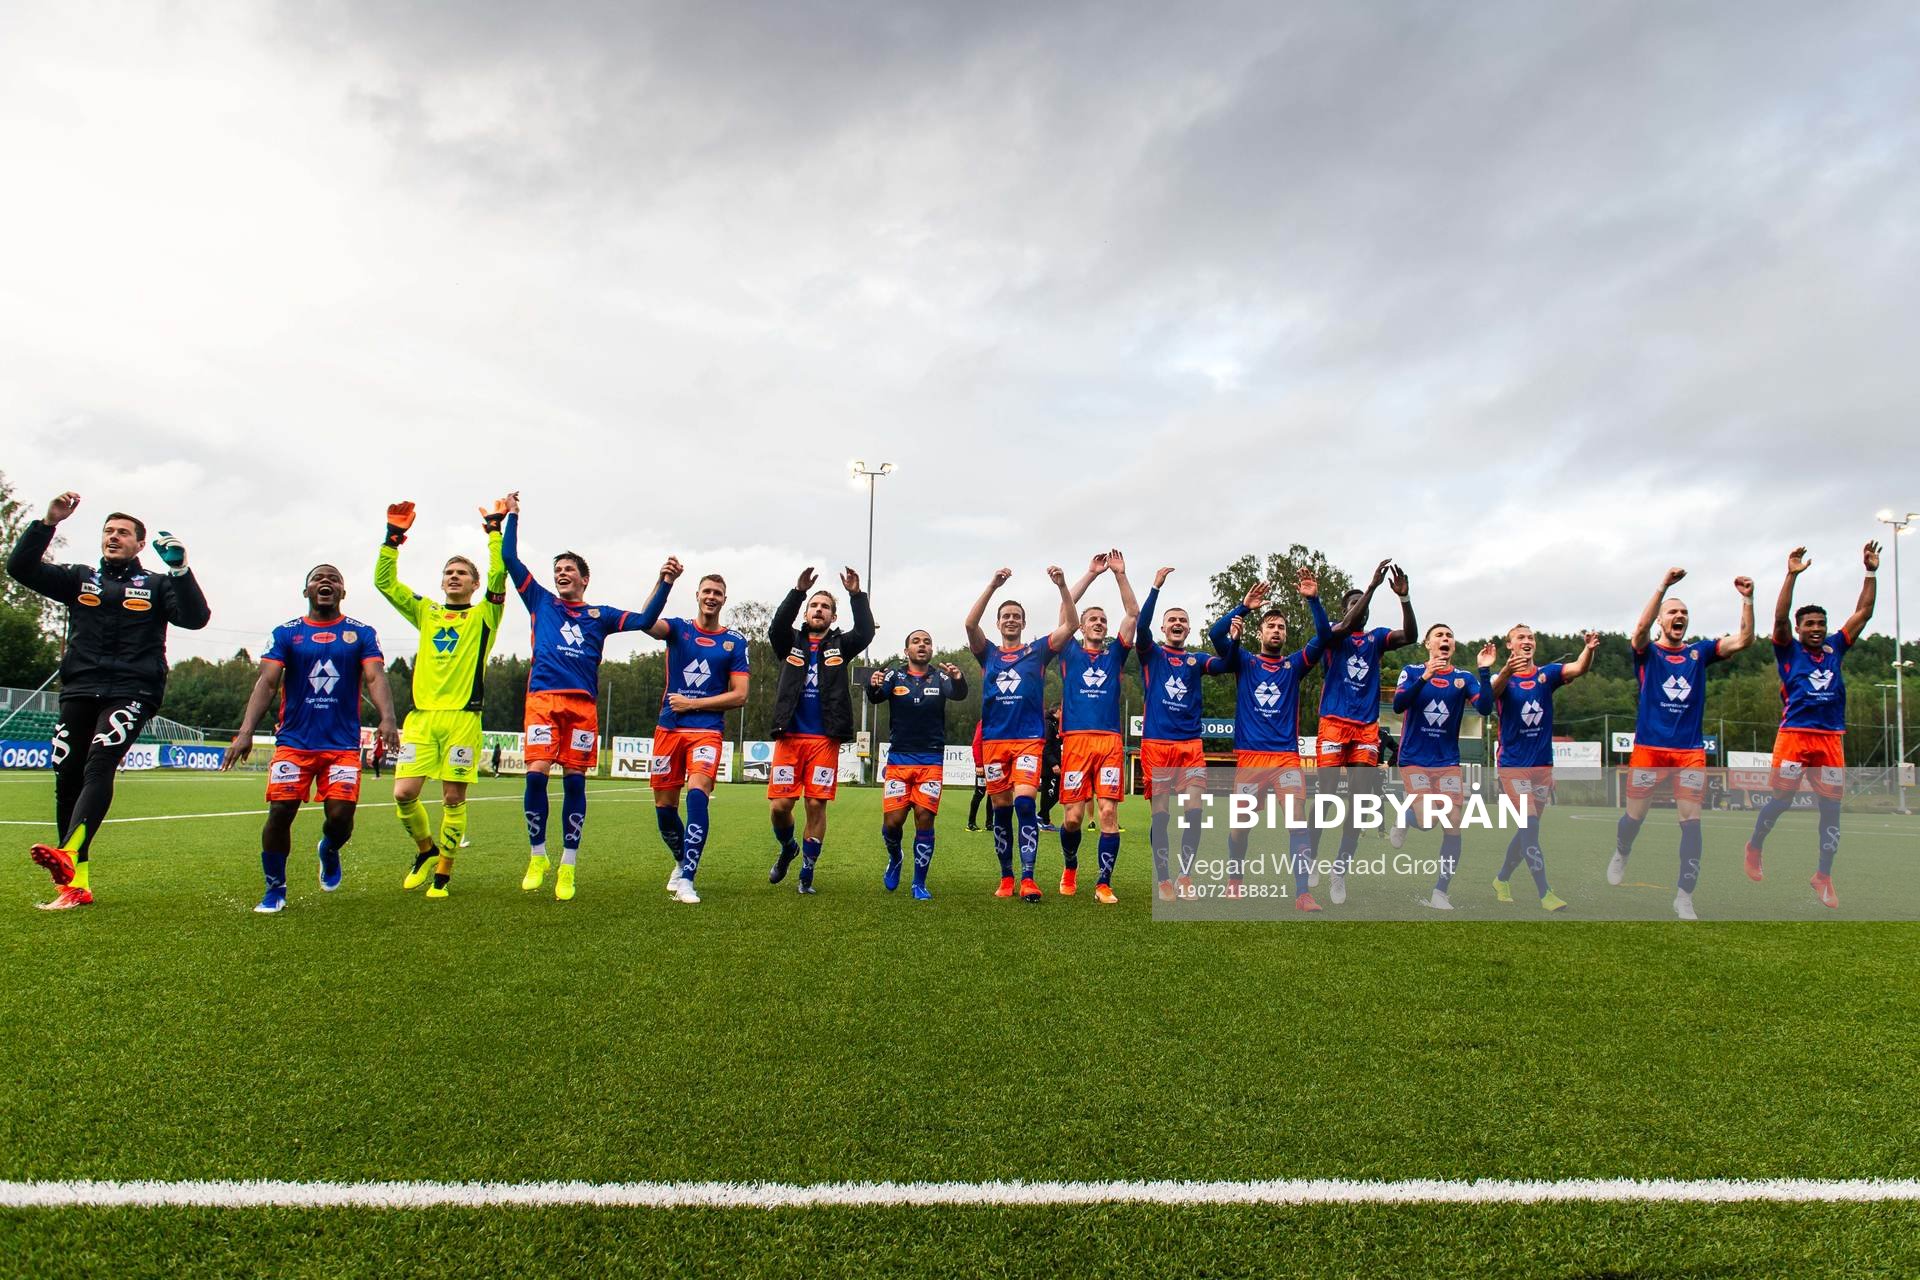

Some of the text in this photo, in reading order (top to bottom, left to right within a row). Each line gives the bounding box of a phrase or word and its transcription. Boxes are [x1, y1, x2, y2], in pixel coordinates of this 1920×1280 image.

[1207, 723, 1234, 734] OBO
[3, 748, 47, 768] OBOS
[188, 752, 219, 768] OBOS
